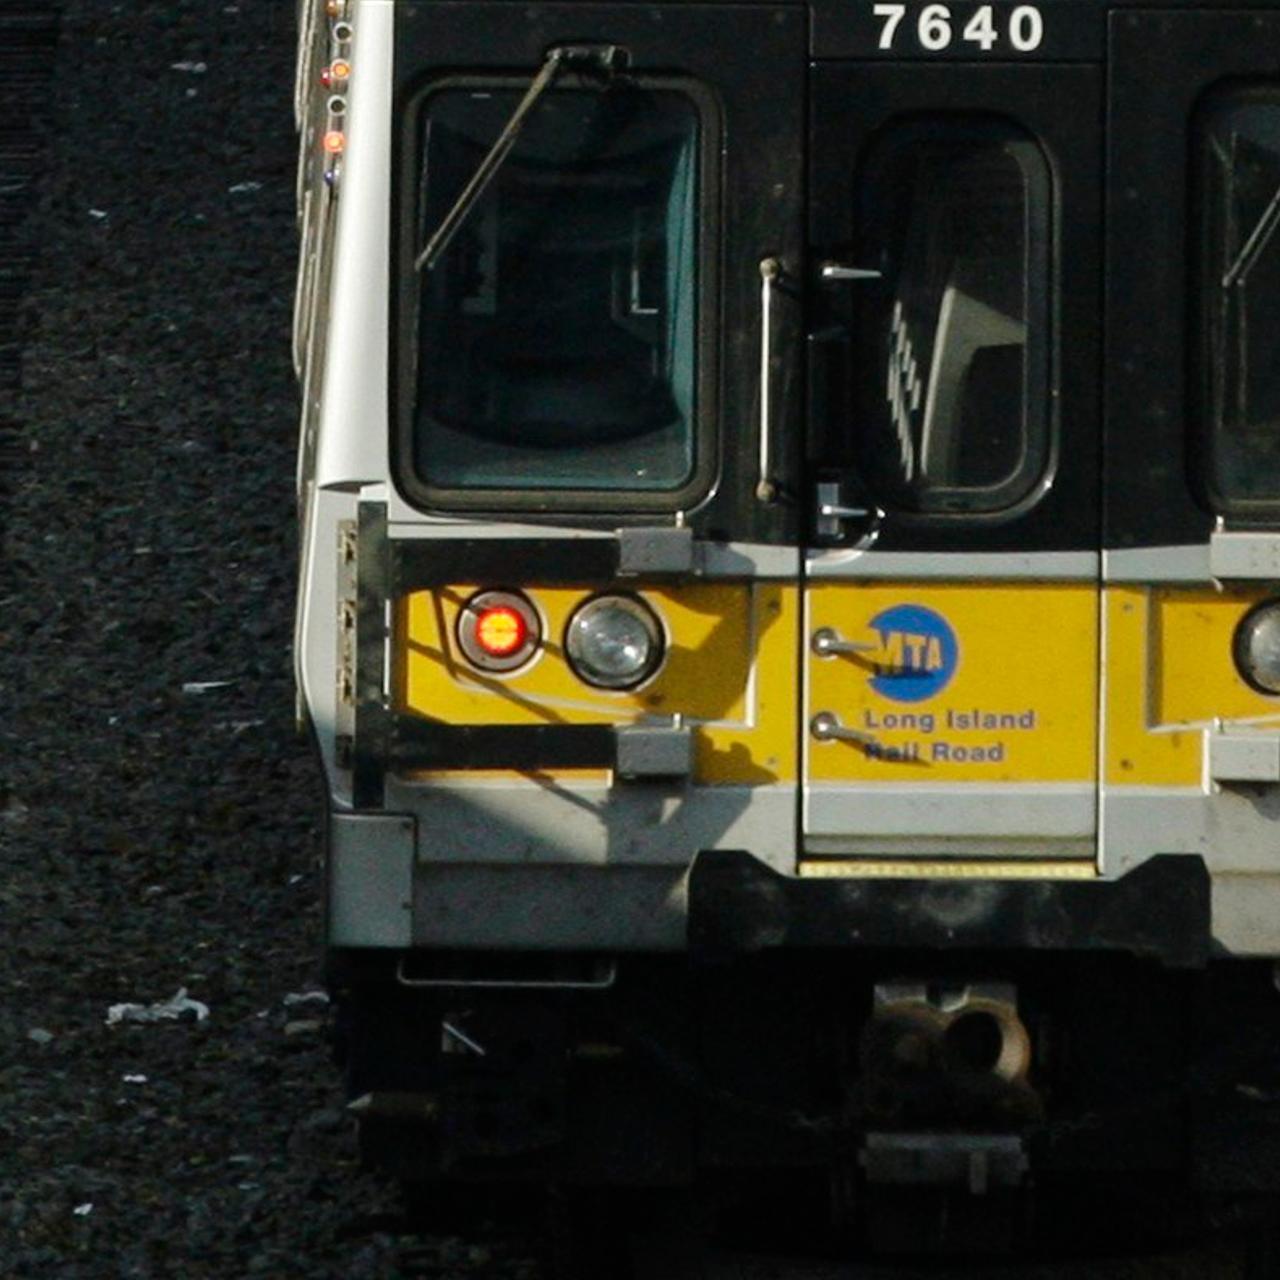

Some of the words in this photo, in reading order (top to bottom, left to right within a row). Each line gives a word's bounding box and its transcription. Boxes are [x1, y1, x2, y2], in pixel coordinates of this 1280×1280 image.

[873, 4, 1044, 51] 7640
[868, 629, 944, 671] MTA
[865, 710, 935, 735] Long
[947, 709, 1035, 729] Island
[865, 742, 920, 762] Rail
[932, 742, 1004, 762] Road
